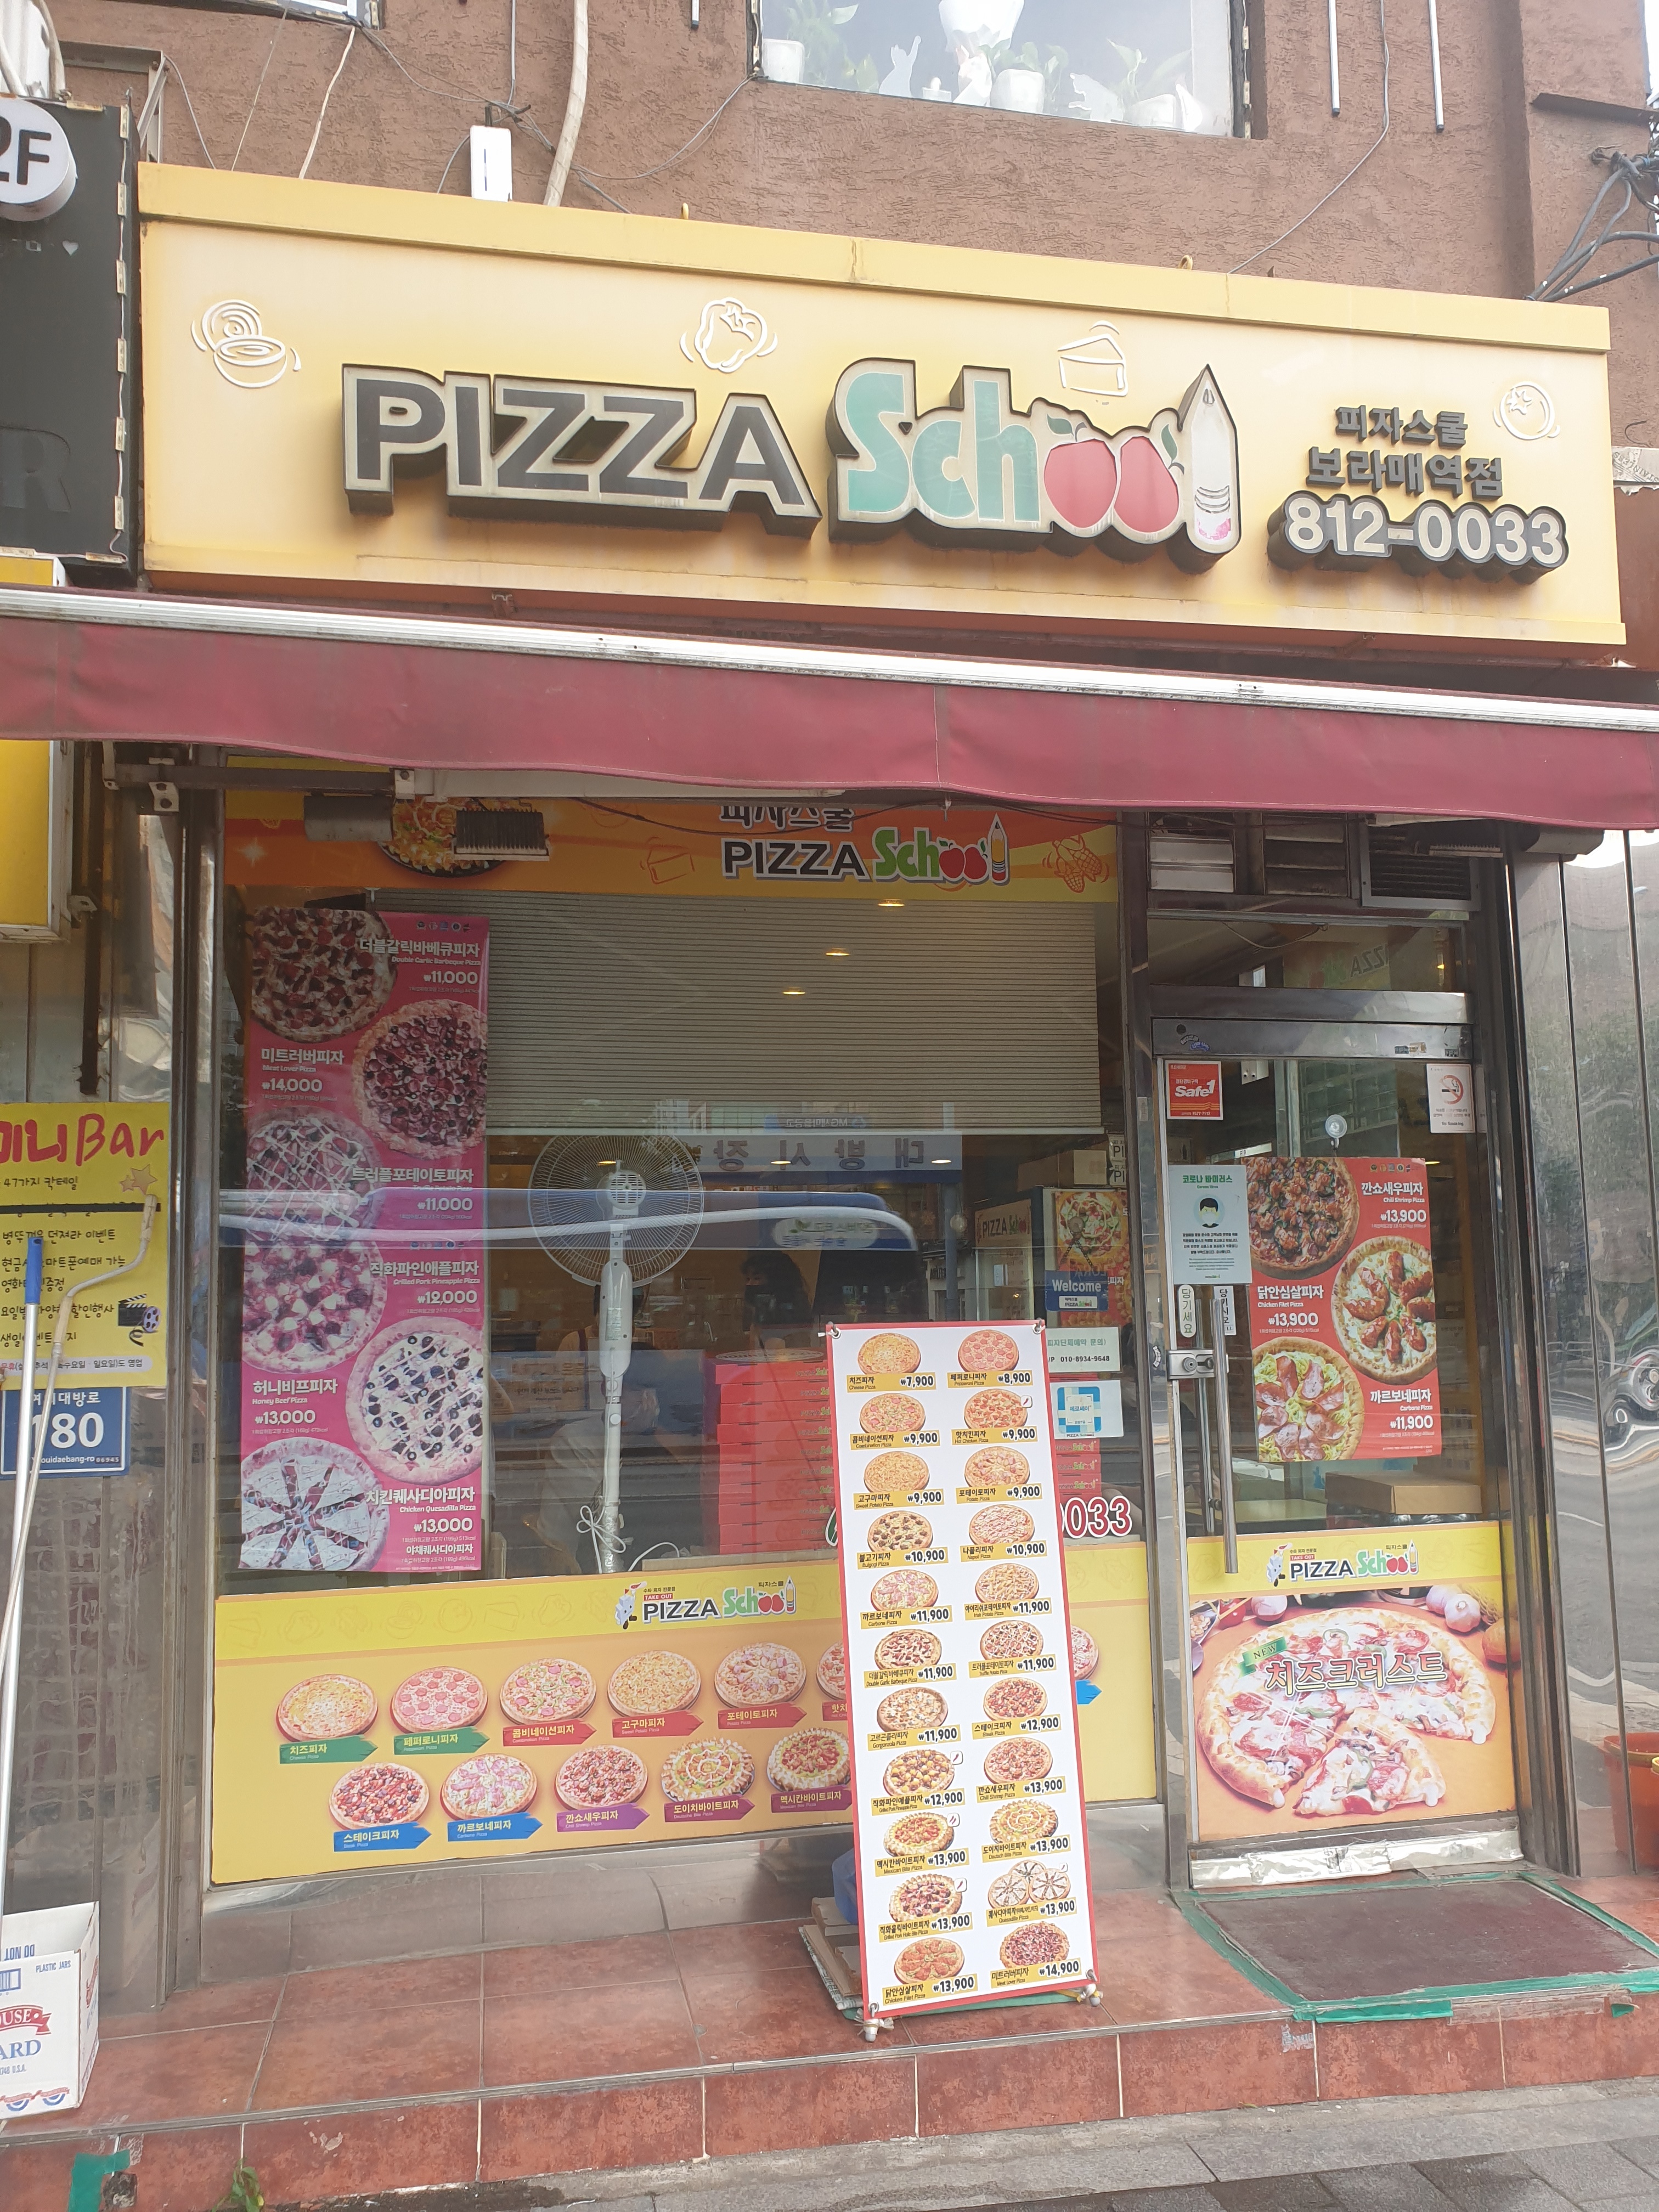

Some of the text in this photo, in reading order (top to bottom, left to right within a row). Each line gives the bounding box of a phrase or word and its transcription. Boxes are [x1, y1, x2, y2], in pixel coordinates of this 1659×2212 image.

[1335, 405, 1468, 448] 피자스쿨
[343, 357, 1241, 554] PIZZA School
[1306, 447, 1503, 500] 보라매역점
[1283, 492, 1568, 567] 812-0033
[721, 812, 1009, 884] PIZZA School
[360, 938, 481, 958] 더블갈릭바베큐피자
[261, 1047, 345, 1065] 미트러버피자
[351, 1167, 474, 1183] 트러플포테이토피자
[1182, 1175, 1233, 1183] 코로나 바이러스
[4, 1176, 78, 1190] 47가지 칵테일
[1361, 1182, 1424, 1196] 깐쇼새우피자
[1380, 1209, 1426, 1224] ₩13,900
[982, 1217, 1007, 1238] PIZZA
[48, 1230, 82, 1245] 던져라
[86, 1229, 116, 1244] 이벤트
[370, 1260, 479, 1277] 직화파인애플피자
[1052, 1279, 1102, 1293] Welcome
[1257, 1285, 1324, 1300] 닭안심살피자
[1182, 1288, 1193, 1334] 당기세요
[1268, 1312, 1318, 1328] ₩13,900
[128, 1359, 143, 1368] 영업
[900, 1376, 934, 1388] ₩7,900
[998, 1373, 1030, 1384] ₩8,900
[253, 1379, 338, 1396] 허니비프피자
[33, 1392, 101, 1407] 여대방로
[1370, 1388, 1432, 1404] 까르보네피자
[255, 1409, 316, 1426] ₩13,000
[1390, 1415, 1434, 1431] ₩11,900
[32, 1412, 104, 1448] 180
[1002, 1429, 1035, 1439] ₩9,900
[853, 1433, 938, 1444] 콤비네이션피자 ₩9,900
[32, 1455, 95, 1464] ouidaebang-ro
[366, 1486, 475, 1505] 치킨퀘사디아피자
[858, 1492, 941, 1503] 고구마피자 ₩9,900
[959, 1486, 1040, 1497] 포테이토피자 ₩9,900
[425, 1505, 459, 1513] Quesadilla
[1060, 1495, 1132, 1538] 033
[414, 1517, 473, 1534] ₩13,000
[406, 1543, 473, 1555] 야채퀘사디아피자
[905, 1550, 945, 1561] ₩10,900
[963, 1543, 1045, 1555] 나폴리피자 ₩10,900
[1290, 1539, 1418, 1582] PIZZA School
[643, 1576, 796, 1622] PIZZA School
[966, 1601, 1049, 1612] 아이리쉬포테이토피자 ₩11,900
[862, 1610, 949, 1621] 까르보네피자 ₩11,900
[1252, 1643, 1277, 1660] NEW
[972, 1658, 1054, 1671] 트러플포테이토피자 ₩11,900
[869, 1666, 953, 1679] 더블갈릭바베큐피자 ₩11,900
[1265, 1651, 1448, 1697] 치즈크러스트
[727, 1708, 778, 1721] 포테이토피자
[512, 1724, 575, 1738] 콤비네이션피자
[622, 1718, 665, 1729] 고구마피자
[974, 1718, 1059, 1731] 스테이크피자 ₩12,900
[403, 1734, 459, 1746] 페퍼로니피자
[918, 1729, 957, 1741] ₩11,900
[290, 1743, 328, 1755] 치즈피자
[979, 1780, 1062, 1793] 깐쇼새우피자 ₩13,900
[780, 1791, 842, 1804] 멕시칸바이트피자
[873, 1792, 963, 1807] 직화파인애플피자 ₩12,900
[674, 1799, 739, 1814] 도이치바이트피자
[566, 1810, 618, 1824] 깐쇼새우피자
[457, 1820, 512, 1832] 까르보네피자
[343, 1830, 399, 1843] 스테이크피자
[984, 1838, 1068, 1854] 도이치바이트피자 ₩13,900
[877, 1852, 966, 1868] 멕시칸바이트피자 ₩13,900
[1040, 1900, 1075, 1914] ₩13,900
[880, 1915, 970, 1934] 직화홀릭바이트피자 ₩13,900
[36, 1960, 71, 1973] PLASTIC JARS
[992, 1961, 1079, 1979] 미트러버피자 ₩14,900
[885, 1977, 974, 1998] 닭안심살피자 ₩13,900
[0, 2008, 32, 2026] USE
